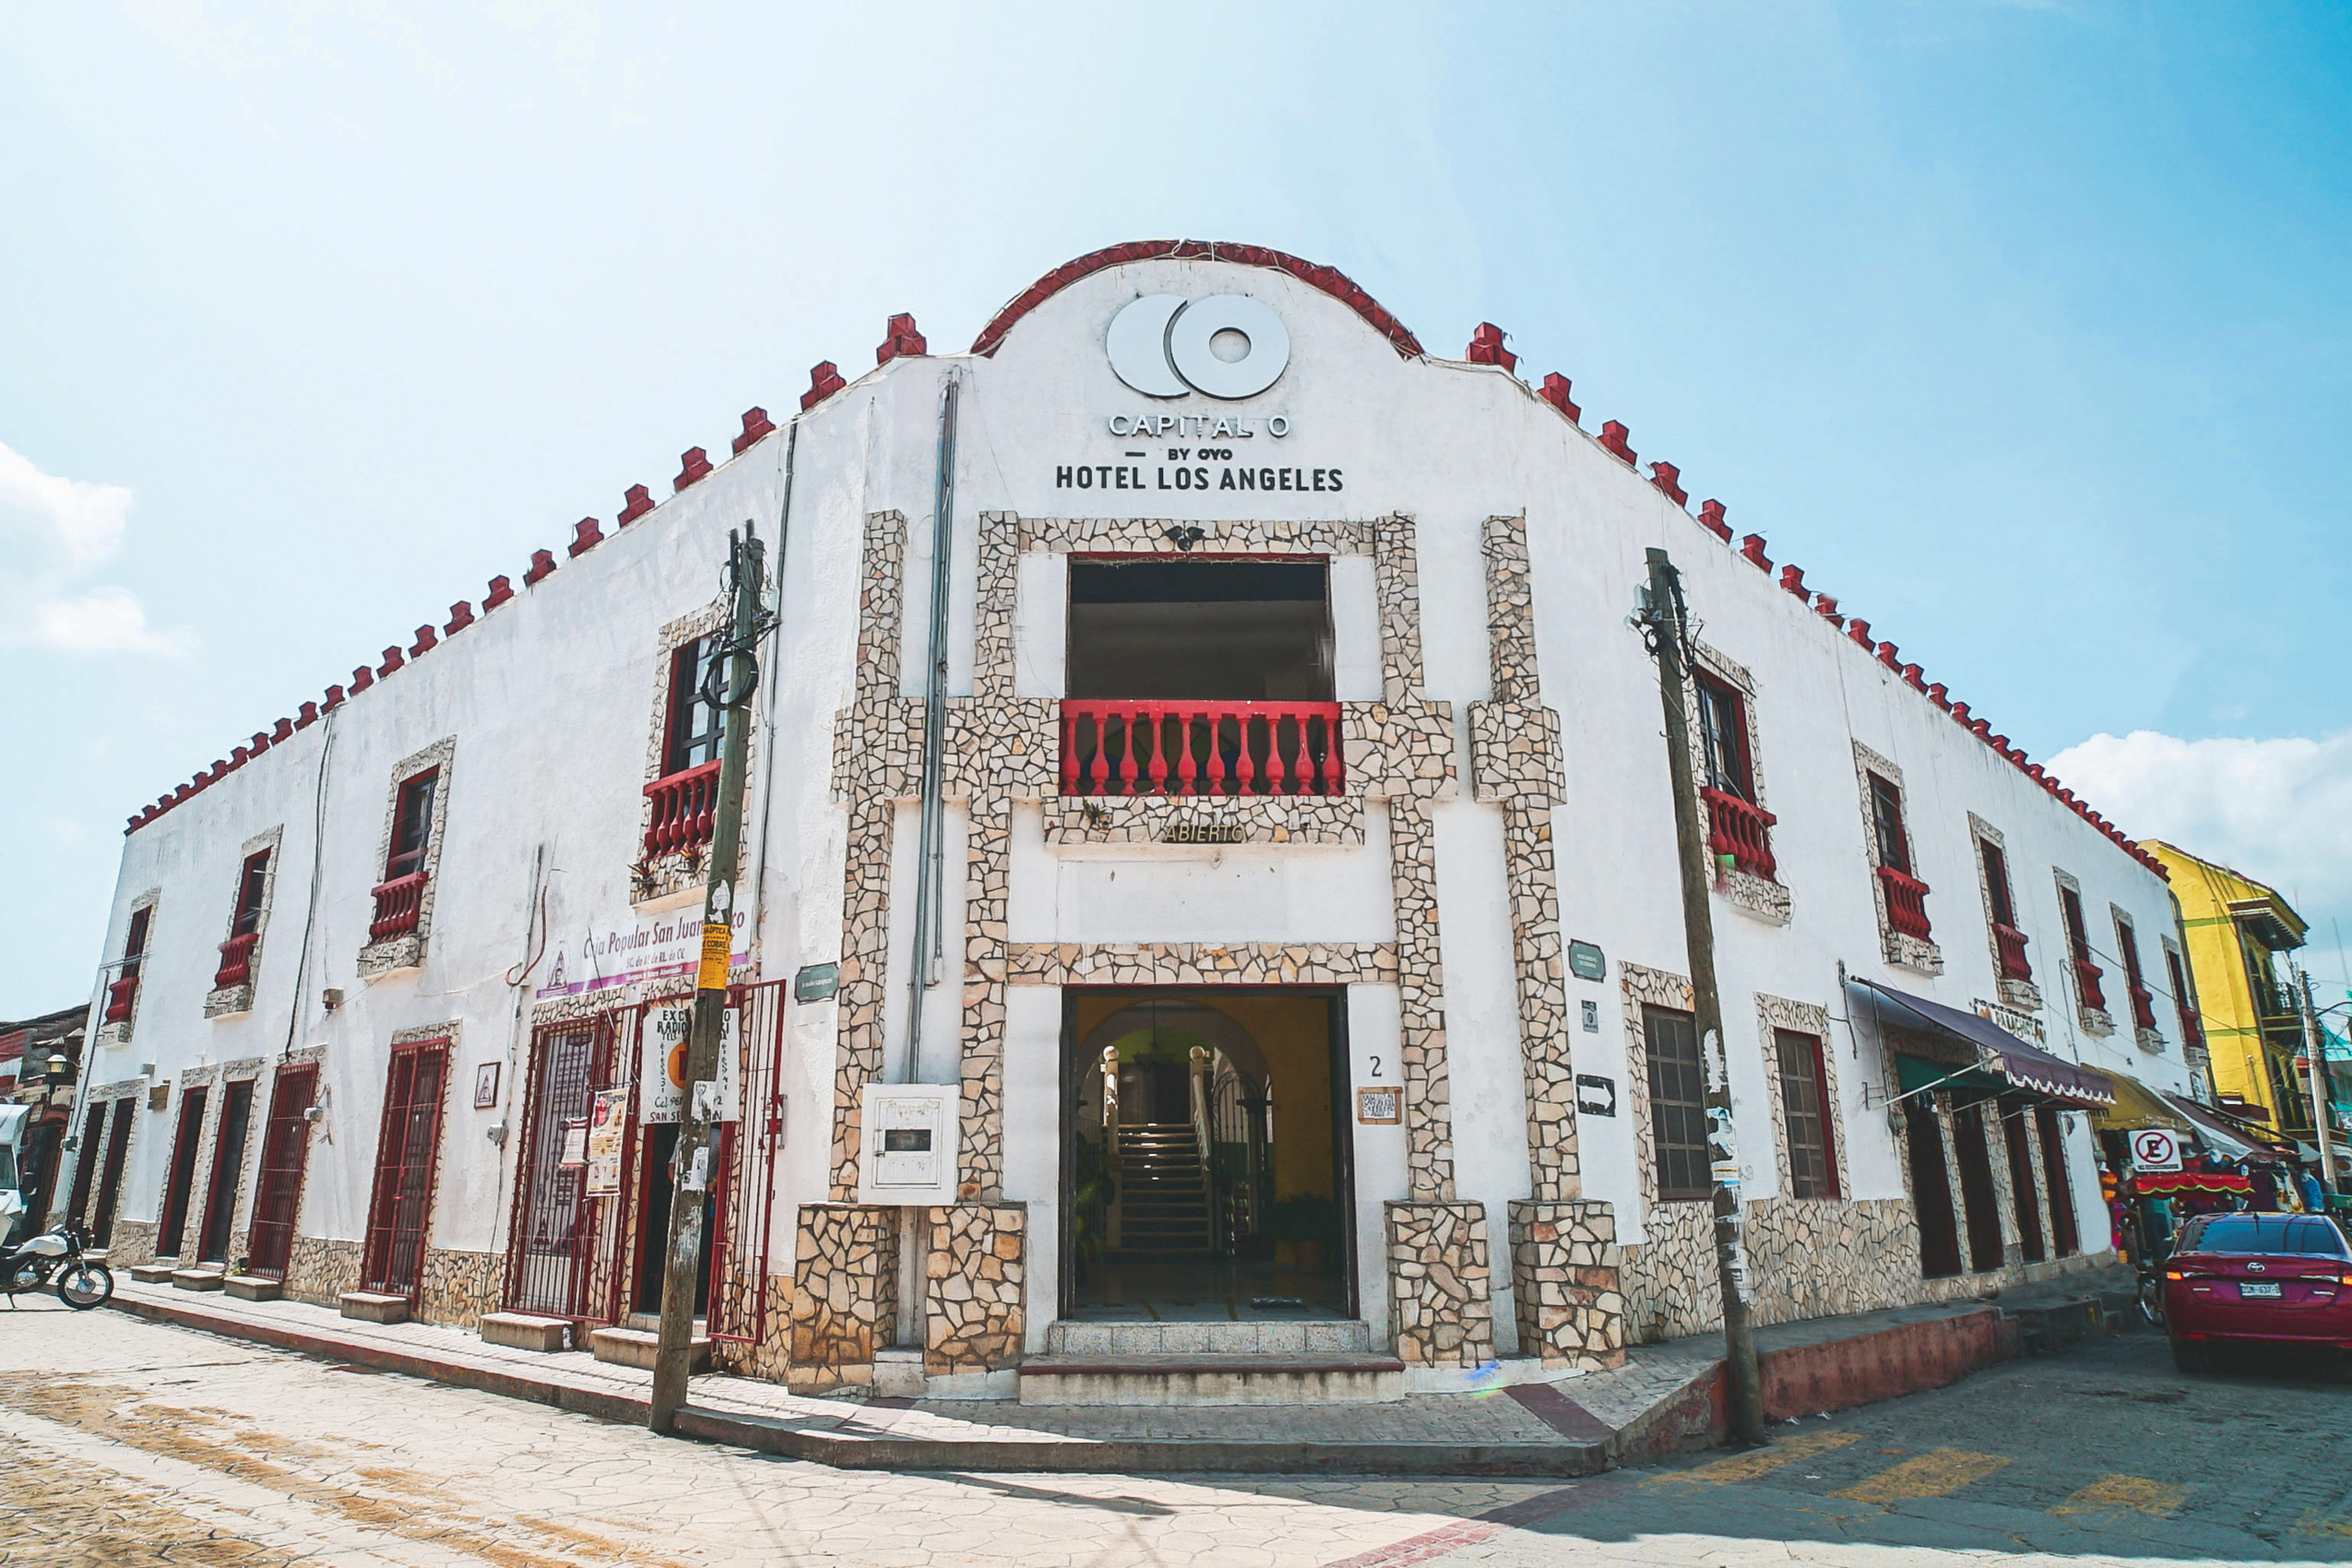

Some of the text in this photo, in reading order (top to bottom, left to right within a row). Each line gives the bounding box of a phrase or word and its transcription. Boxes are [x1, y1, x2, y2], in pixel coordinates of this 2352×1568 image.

[1108, 415, 1290, 438] CAPITAL O
[1168, 448, 1232, 461] BY OYO
[1056, 466, 1343, 492] HOTEL LOS ANGELES
[1165, 825, 1245, 843] ABIERTO
[608, 924, 650, 957] Popular
[653, 921, 674, 945] San
[676, 915, 704, 940] Juan
[657, 1022, 687, 1035] RADIO
[1370, 1055, 1382, 1077] 2
[650, 1111, 667, 1122] SAN
